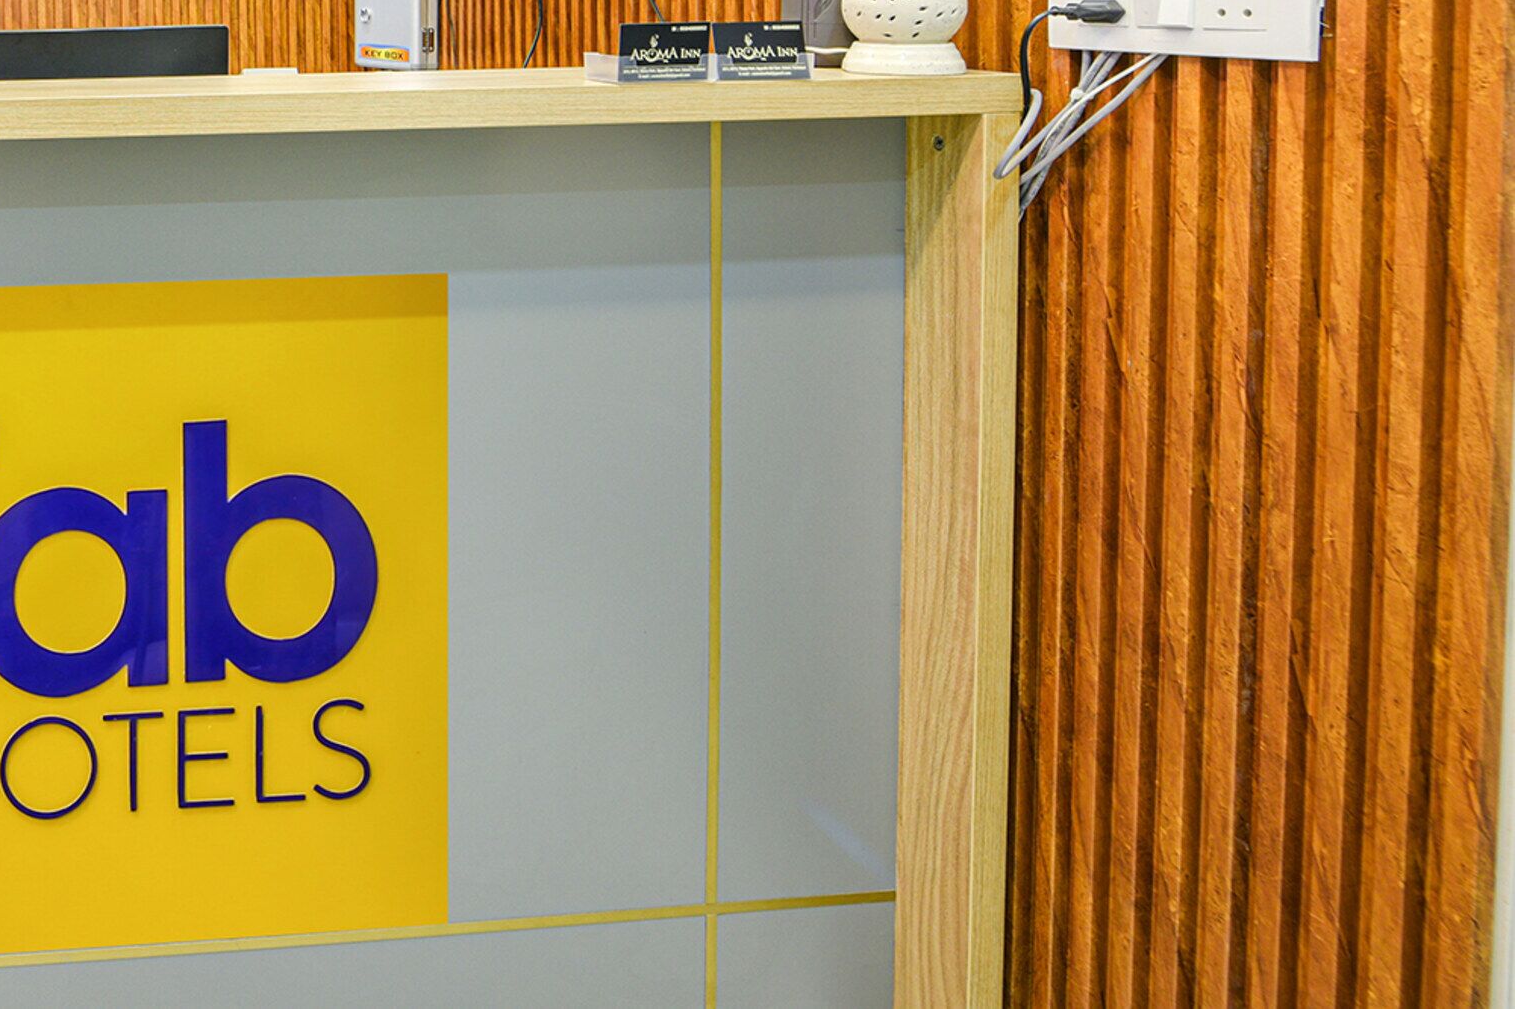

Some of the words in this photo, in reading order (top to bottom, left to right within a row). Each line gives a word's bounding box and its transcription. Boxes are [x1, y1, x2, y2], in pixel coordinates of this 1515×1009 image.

[364, 49, 382, 58] KEY
[384, 50, 404, 61] BOX
[630, 46, 678, 63] AROMA
[680, 48, 701, 59] INN
[726, 44, 776, 61] AROMA
[777, 46, 798, 57] INN
